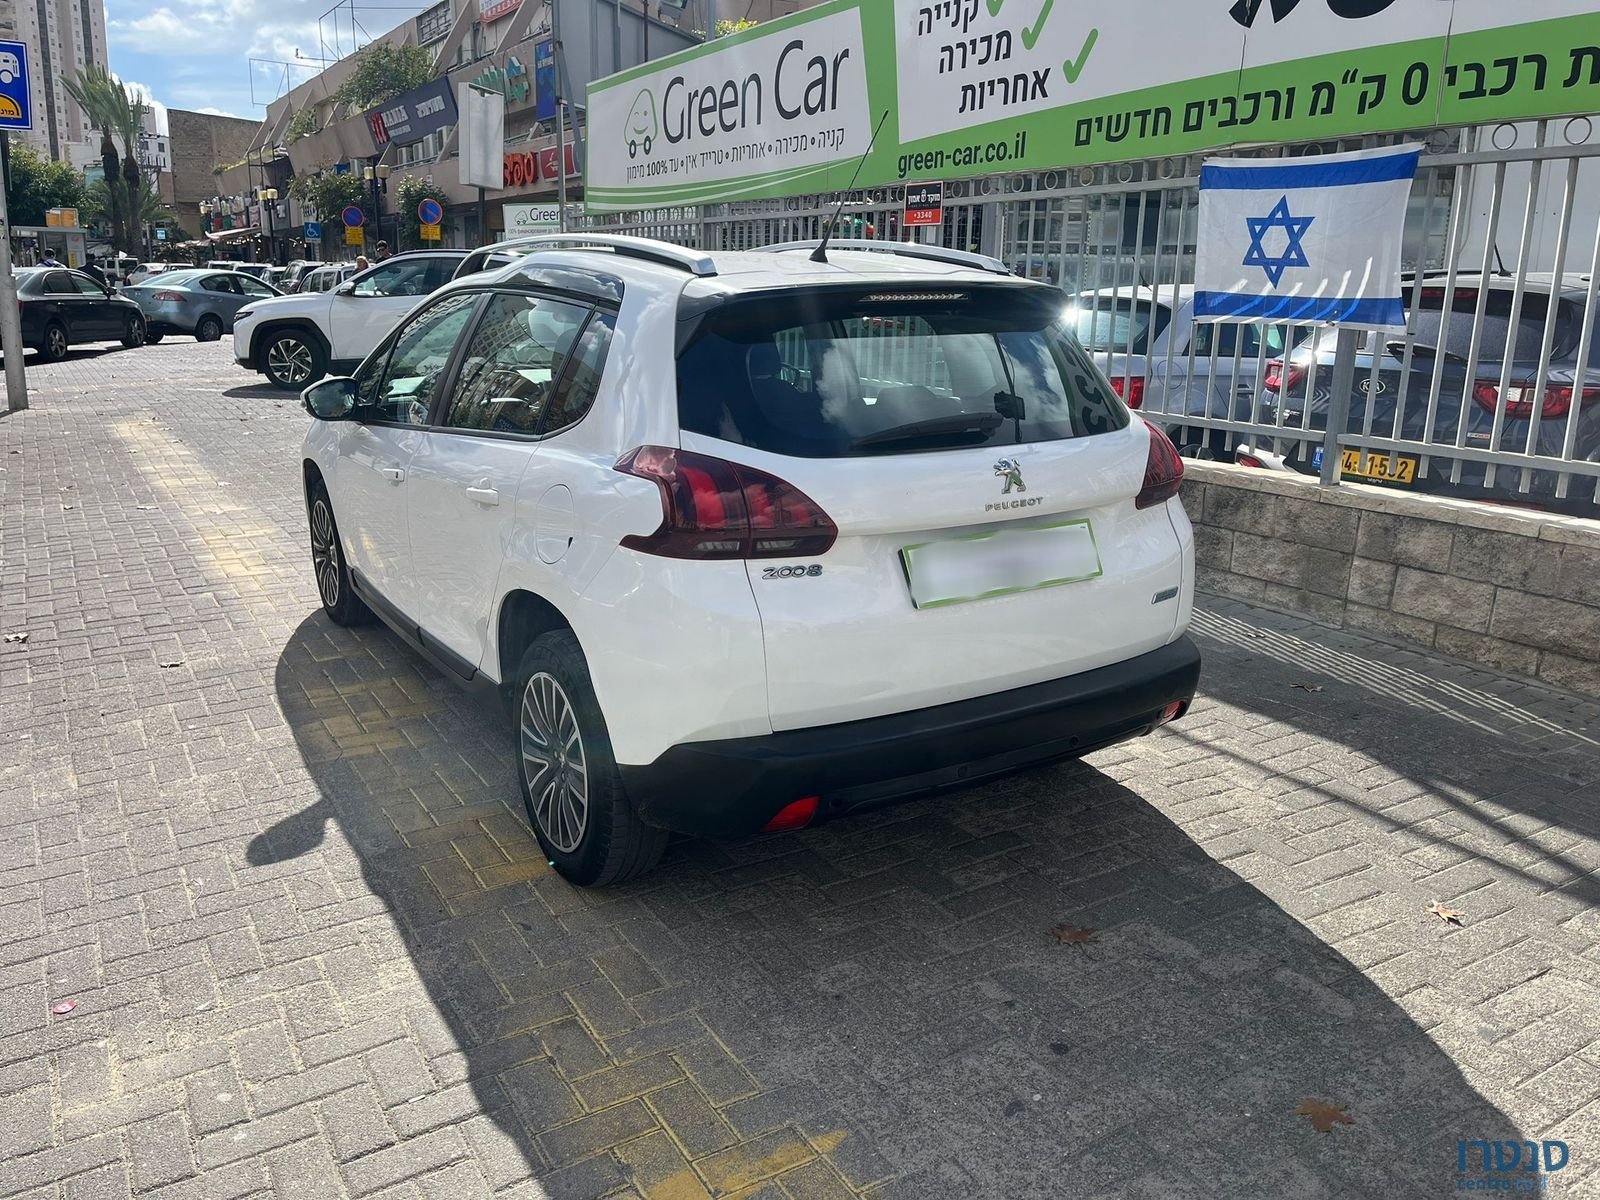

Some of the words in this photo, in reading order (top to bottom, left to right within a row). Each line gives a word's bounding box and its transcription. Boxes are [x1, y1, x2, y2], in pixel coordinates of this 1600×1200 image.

[918, 0, 979, 36] קנייה
[938, 29, 1012, 74] מכירה
[1401, 61, 1429, 106] 0
[1444, 53, 1547, 99] רכבי
[662, 72, 762, 145] Green
[773, 39, 850, 121] Car
[958, 67, 1051, 114] אחריות
[1181, 86, 1296, 133] ורכבים
[1074, 106, 1172, 147] חדשים
[774, 135, 807, 155] מכירה
[817, 127, 845, 152] קניה
[685, 153, 697, 175] אין
[699, 149, 724, 167] טרייד
[731, 142, 766, 163] אחריות
[897, 131, 1027, 177] green-car.co.il
[626, 163, 645, 184] מימון
[646, 159, 668, 176] 100%
[669, 157, 680, 174] עד
[926, 193, 941, 203] מוקד
[984, 495, 1045, 512] PEUGEOT
[762, 564, 823, 580] 2008
